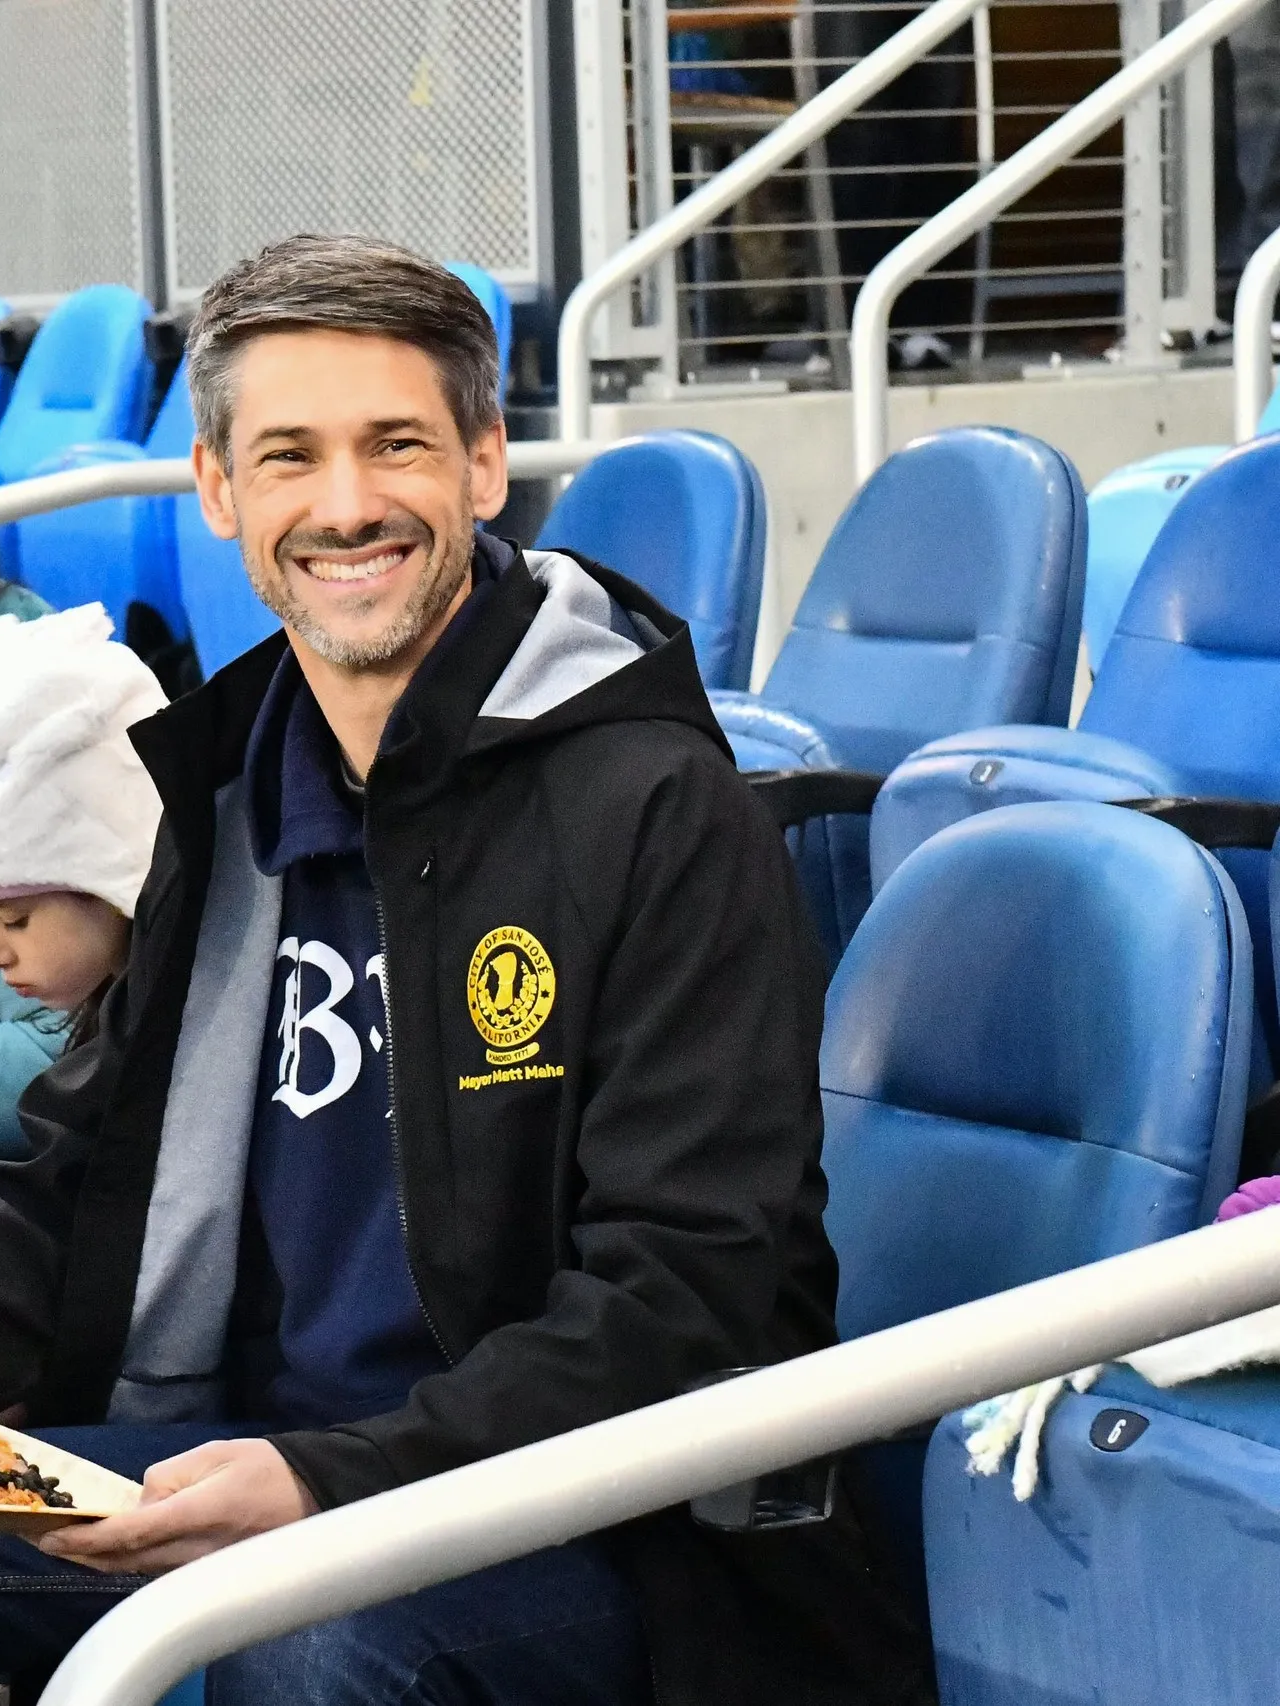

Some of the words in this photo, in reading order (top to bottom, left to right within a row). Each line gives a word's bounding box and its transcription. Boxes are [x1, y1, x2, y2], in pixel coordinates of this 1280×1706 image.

[469, 949, 483, 988] CITY
[484, 932, 498, 949] OF
[501, 929, 524, 942] SAN
[523, 940, 551, 976] JOSÉ
[477, 1012, 543, 1044] CALIFORNIA
[459, 1073, 492, 1091] Mayor
[493, 1068, 524, 1084] Matt
[1107, 1419, 1127, 1444] 6
